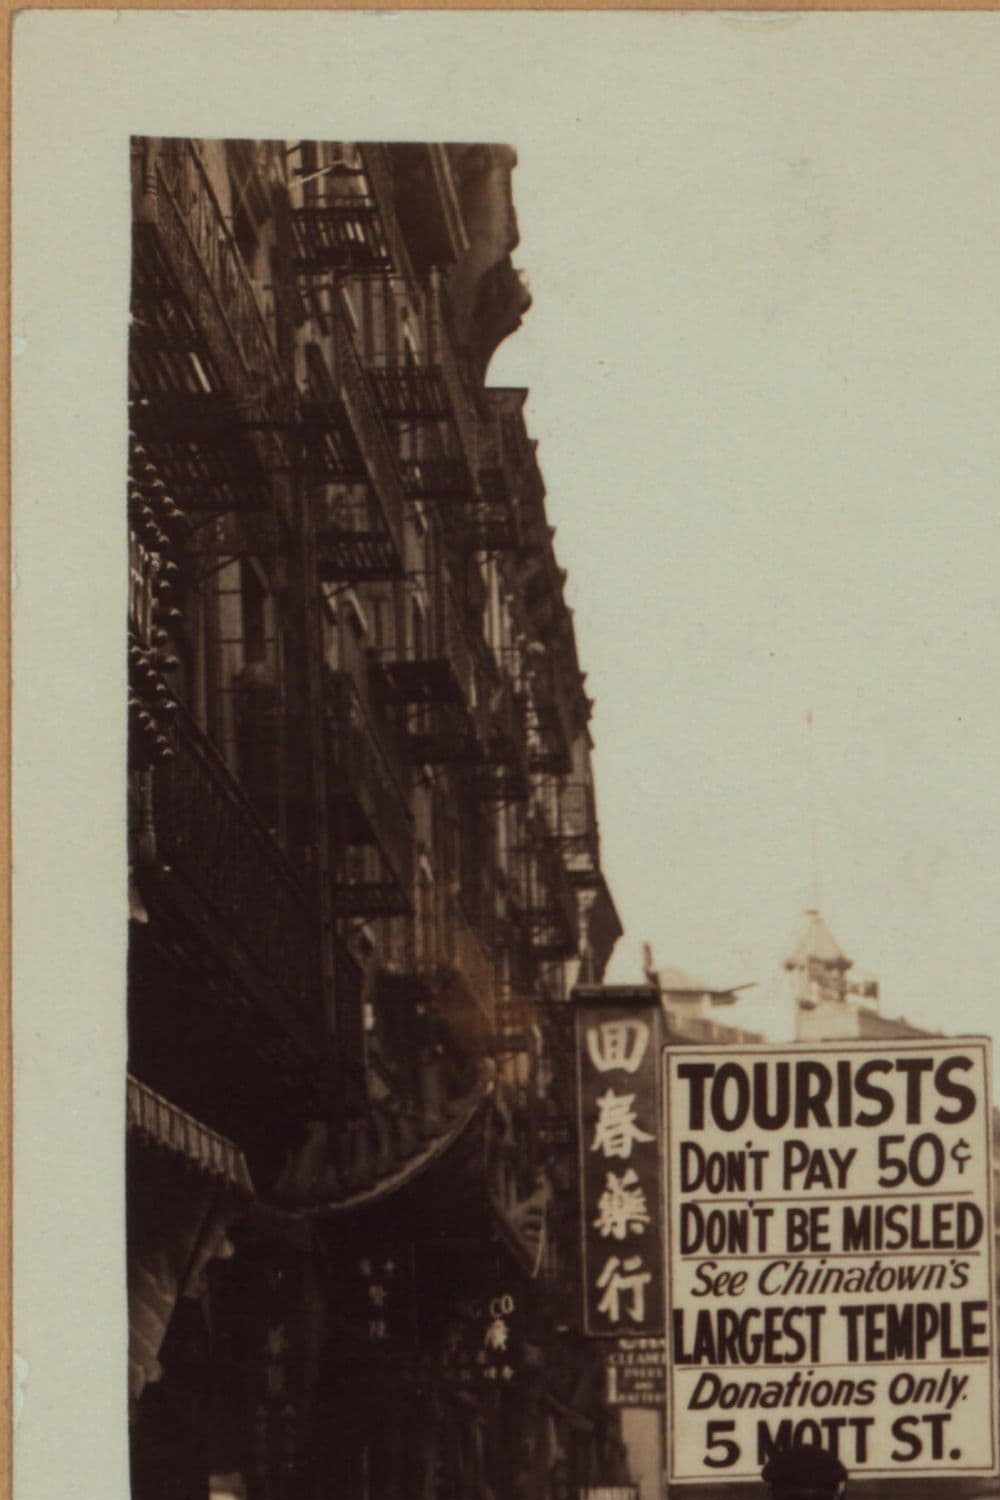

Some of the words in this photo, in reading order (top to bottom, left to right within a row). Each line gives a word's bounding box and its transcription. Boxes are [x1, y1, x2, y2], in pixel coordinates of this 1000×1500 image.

[677, 1056, 976, 1132] TOURISTS
[680, 1141, 769, 1194] DON'T
[783, 1140, 857, 1191] PAY
[878, 1133, 972, 1188] 50¢
[680, 1199, 774, 1255] DON'T
[787, 1207, 831, 1254] BE
[842, 1202, 984, 1253] MISLED
[691, 1261, 747, 1297] See
[758, 1259, 969, 1296] Chinatown's
[673, 1306, 827, 1365] LARGEST
[840, 1301, 989, 1363] TEMPLE
[688, 1371, 876, 1410] Donations
[703, 1420, 741, 1468] 5
[757, 1417, 874, 1465] MOTT
[891, 1413, 961, 1462] ST.
